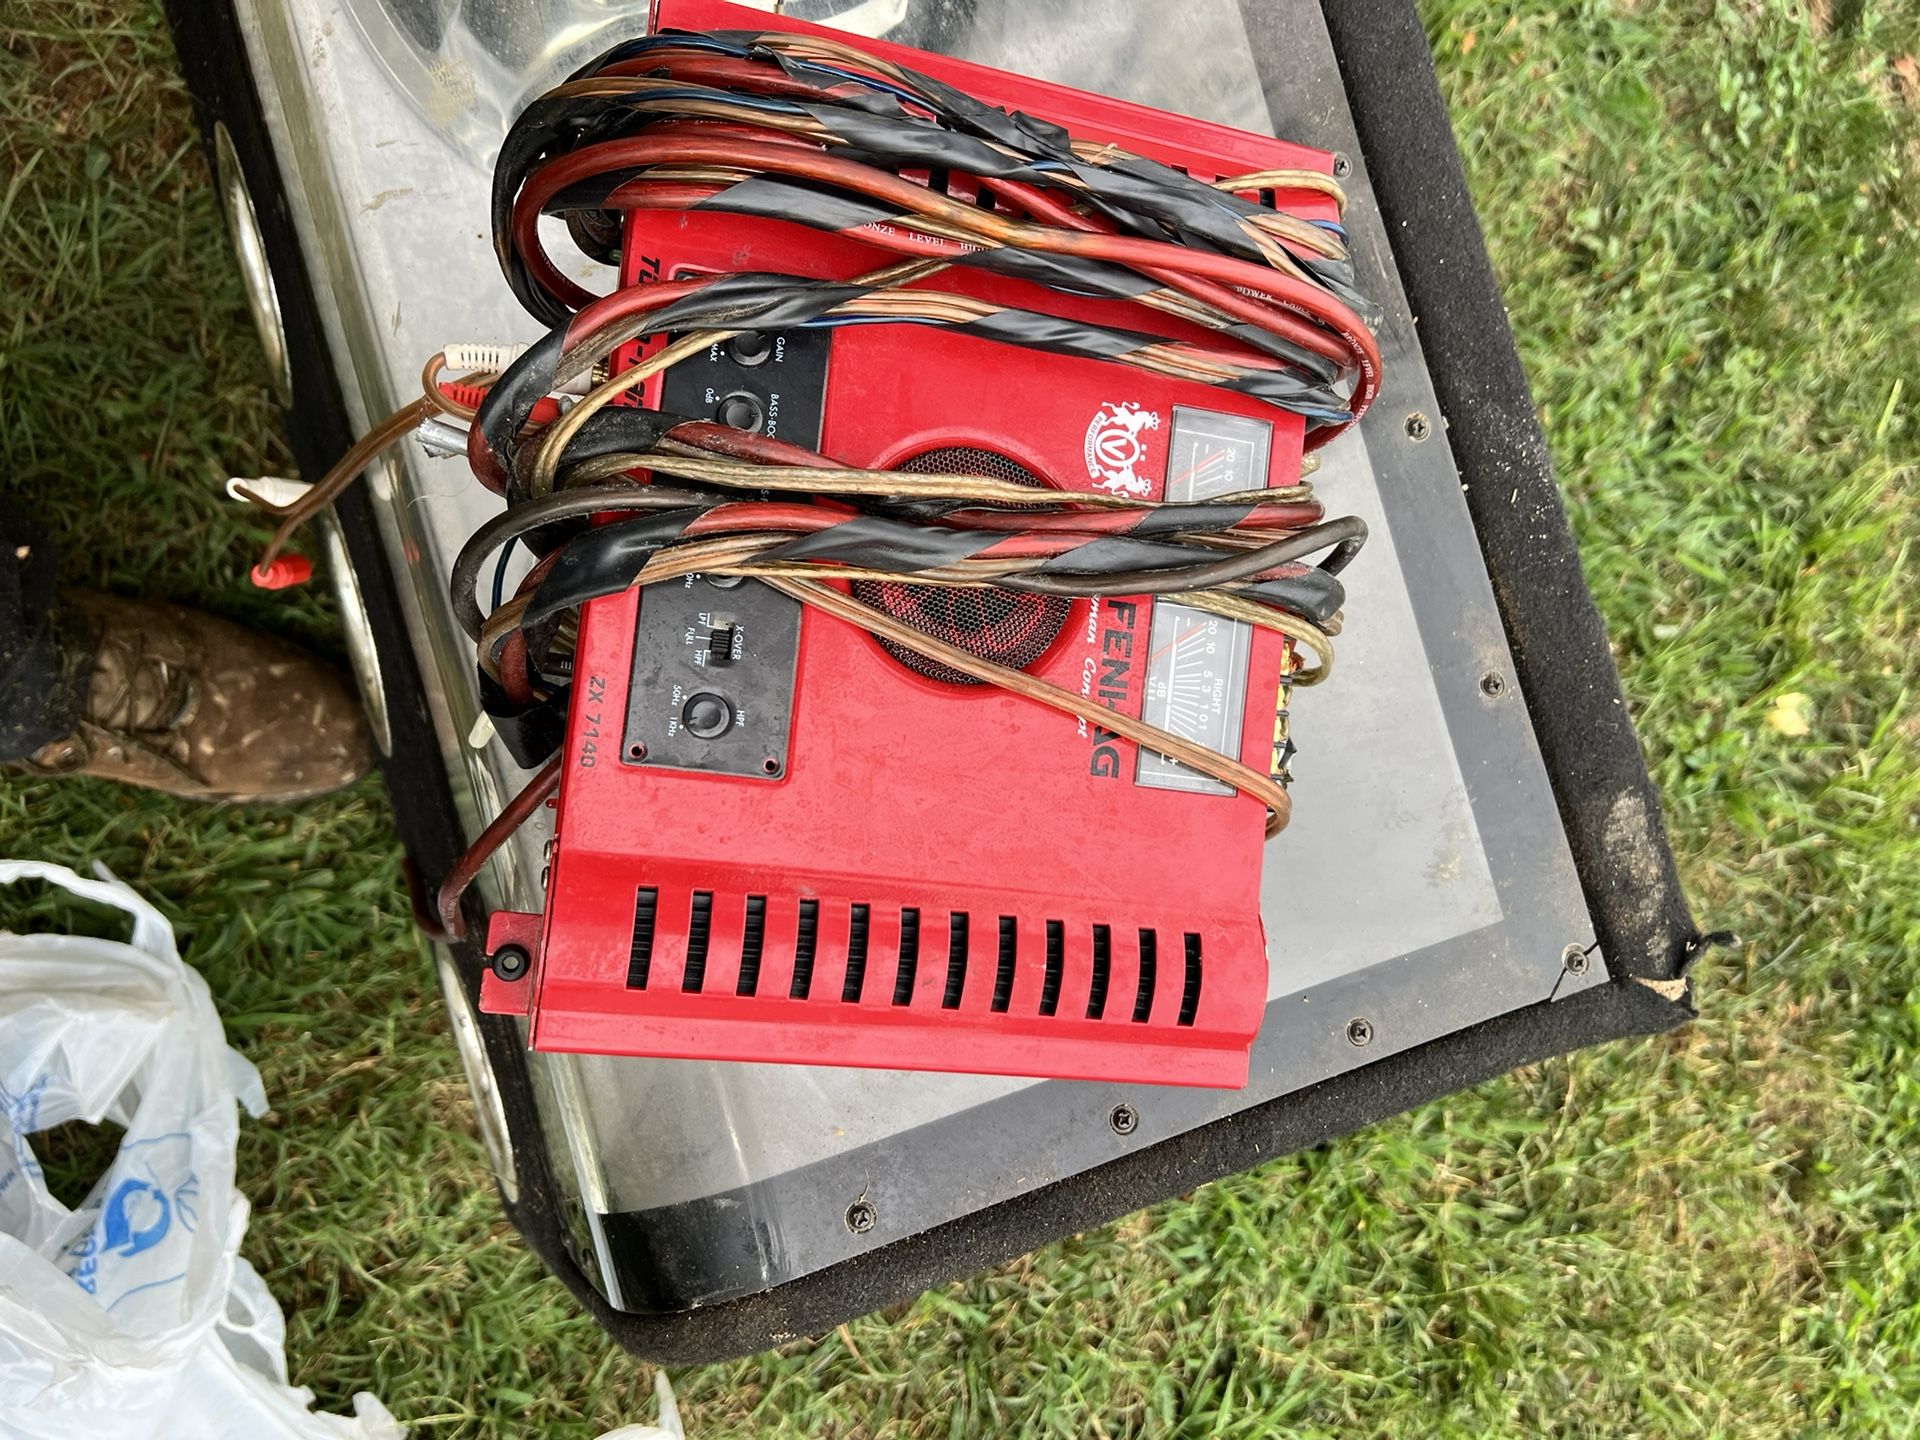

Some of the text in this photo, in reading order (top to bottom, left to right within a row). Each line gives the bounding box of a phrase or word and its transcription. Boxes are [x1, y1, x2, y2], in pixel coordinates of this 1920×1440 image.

[908, 232, 948, 248] LEVEL
[709, 343, 719, 363] MAX
[775, 336, 786, 363] GAIN
[1087, 415, 1104, 475] PERFORMANCE
[1224, 447, 1236, 482] 20 10
[698, 612, 707, 626] LPF
[1207, 620, 1218, 635] 20
[685, 627, 696, 646] FULL
[732, 625, 745, 660] X-OVER
[1205, 641, 1217, 655] 10
[694, 650, 703, 666] HPF
[1203, 670, 1213, 678] 5
[671, 684, 682, 706] 50Hz
[1077, 657, 1097, 738] Conpt
[1156, 681, 1168, 698] dB
[1201, 684, 1211, 693] 3
[1211, 678, 1224, 716] RIGHT
[580, 675, 606, 769] ZX 7140
[668, 717, 678, 738] 1KHz
[736, 710, 746, 728] HPF
